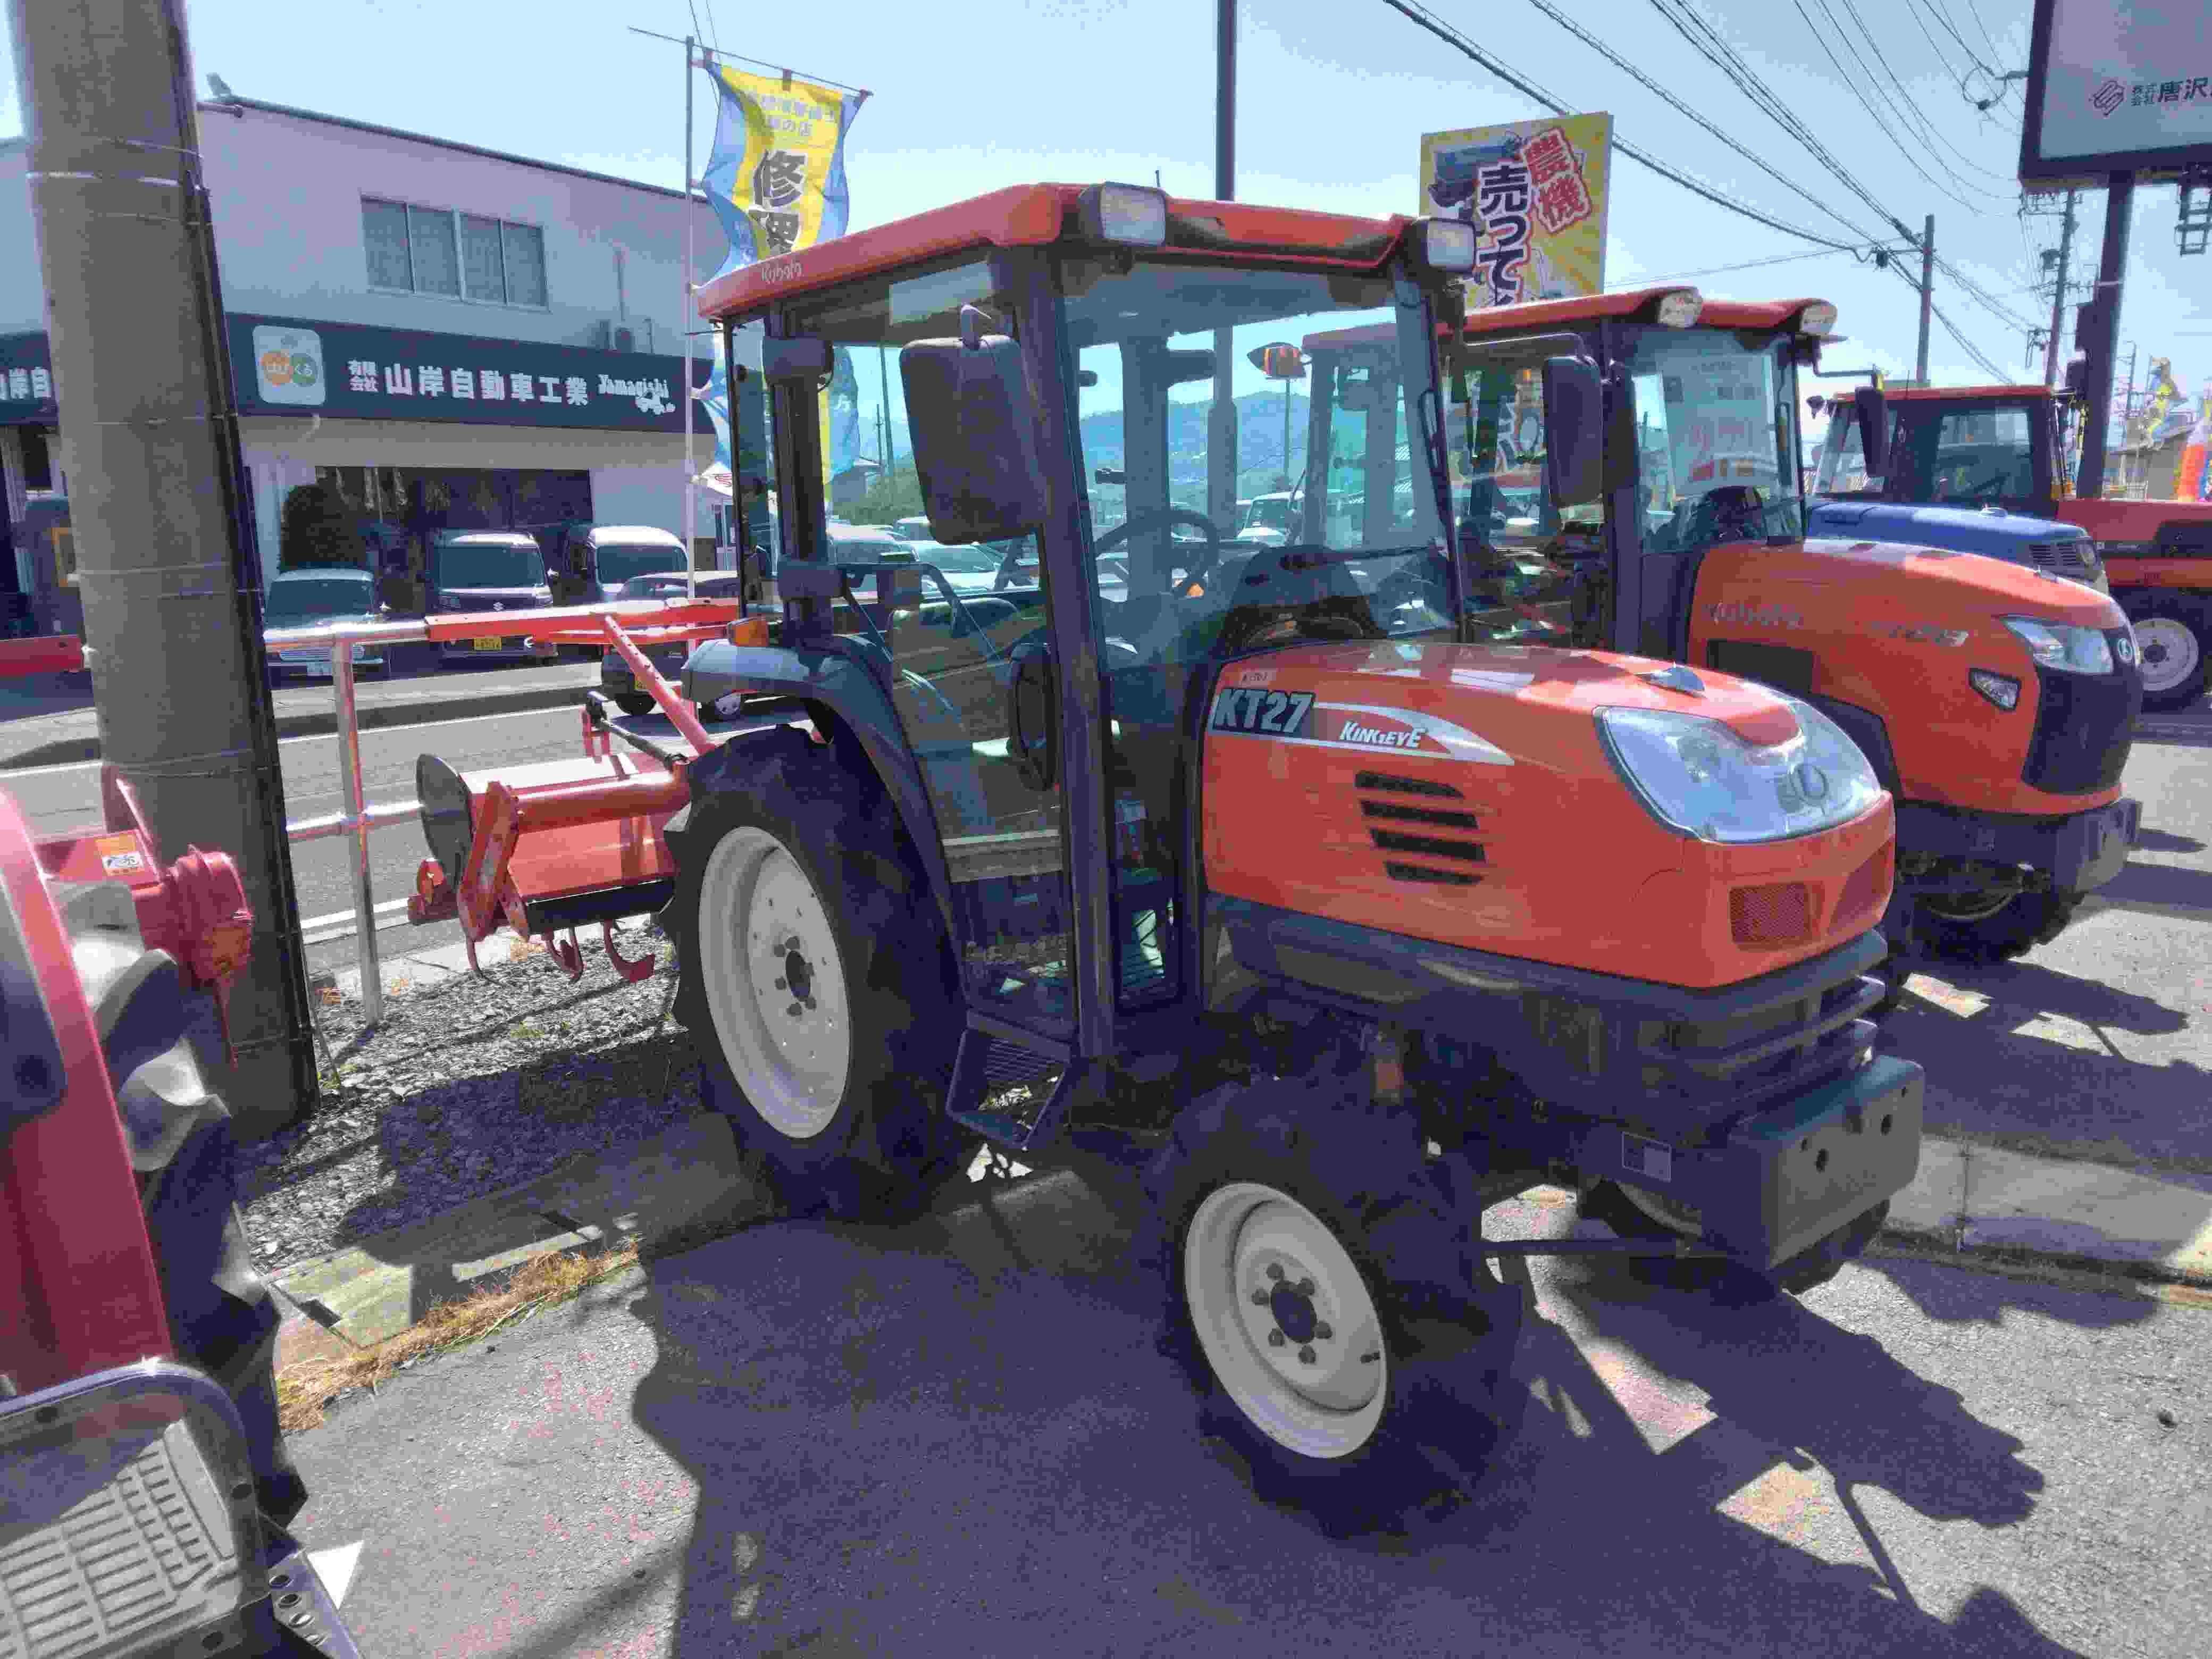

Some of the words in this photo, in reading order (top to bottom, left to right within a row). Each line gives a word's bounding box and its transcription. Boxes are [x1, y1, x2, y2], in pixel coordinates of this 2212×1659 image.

[2158, 77, 2212, 103] 唐沢
[1479, 164, 1529, 306] 売って
[384, 363, 589, 406] 山岸自動車工業
[1214, 689, 1312, 733] KT27
